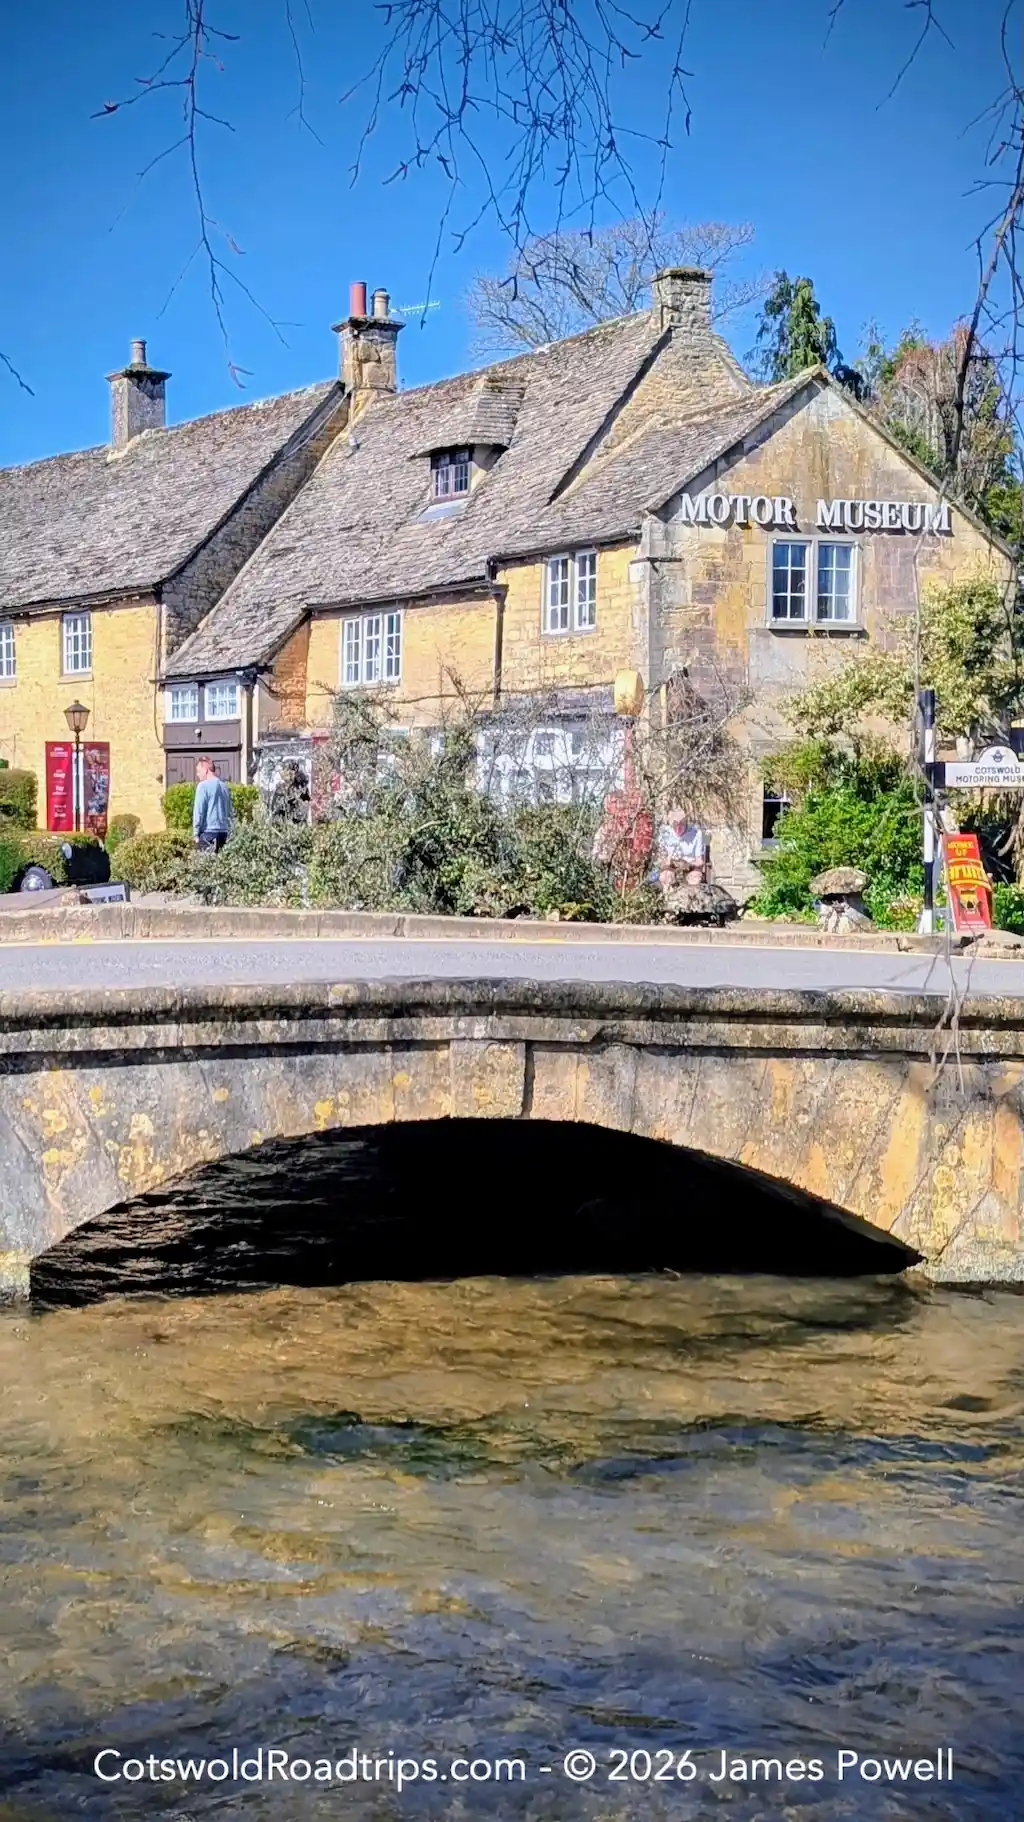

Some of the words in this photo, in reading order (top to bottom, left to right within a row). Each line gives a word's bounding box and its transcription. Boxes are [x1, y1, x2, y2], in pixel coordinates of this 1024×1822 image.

[680, 493, 795, 525] MOTOR
[815, 499, 951, 531] MUSEUM
[974, 766, 1021, 775] COTSWOLD
[955, 775, 1000, 784] MOTORING
[1002, 775, 1024, 784] MUS
